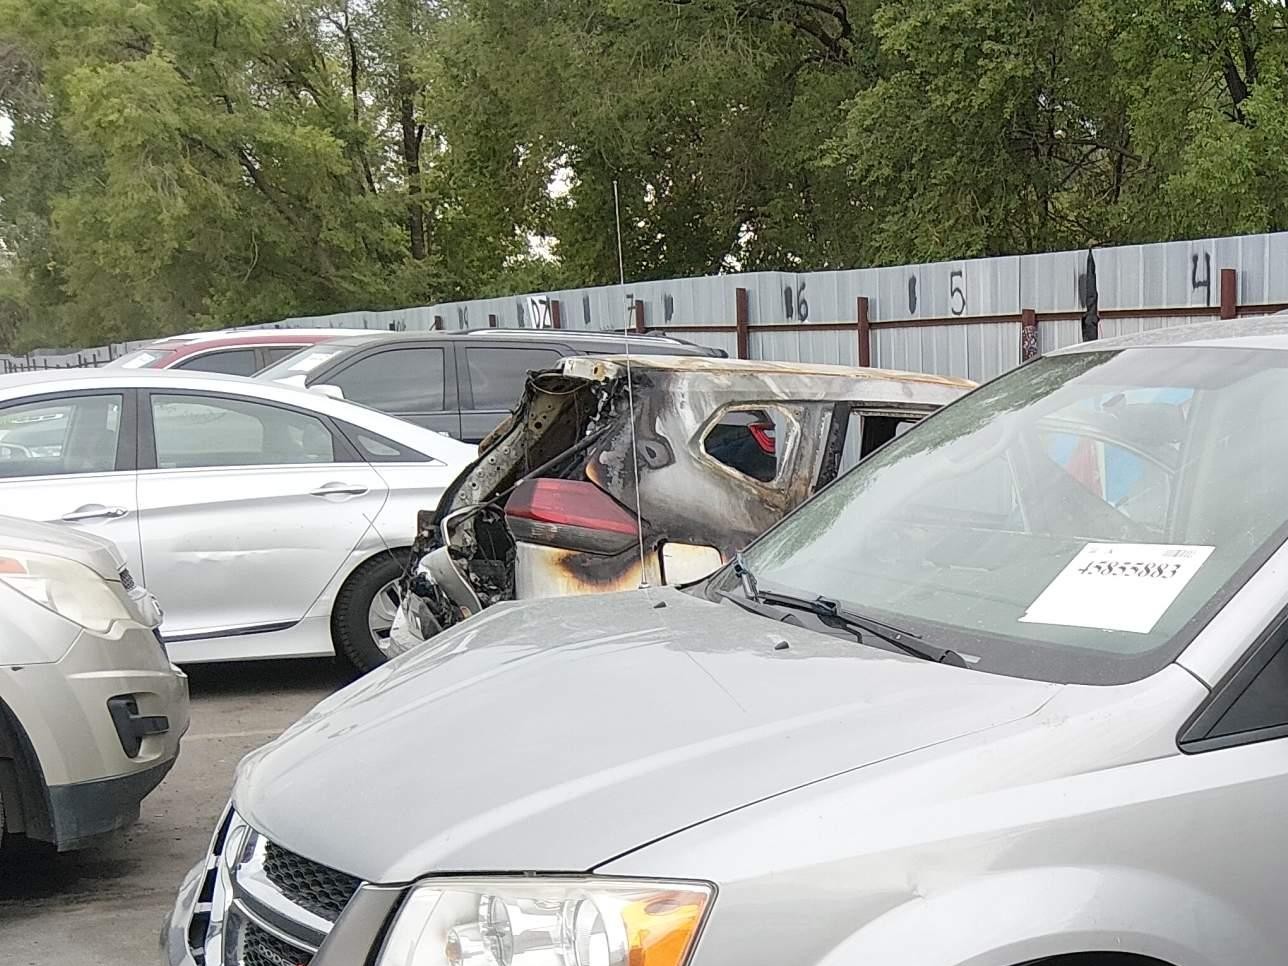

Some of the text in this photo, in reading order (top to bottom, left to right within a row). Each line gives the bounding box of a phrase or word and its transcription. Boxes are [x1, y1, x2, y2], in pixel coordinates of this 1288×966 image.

[950, 270, 966, 316] 5
[1192, 253, 1210, 306] 4
[1077, 560, 1182, 579] 45855883
